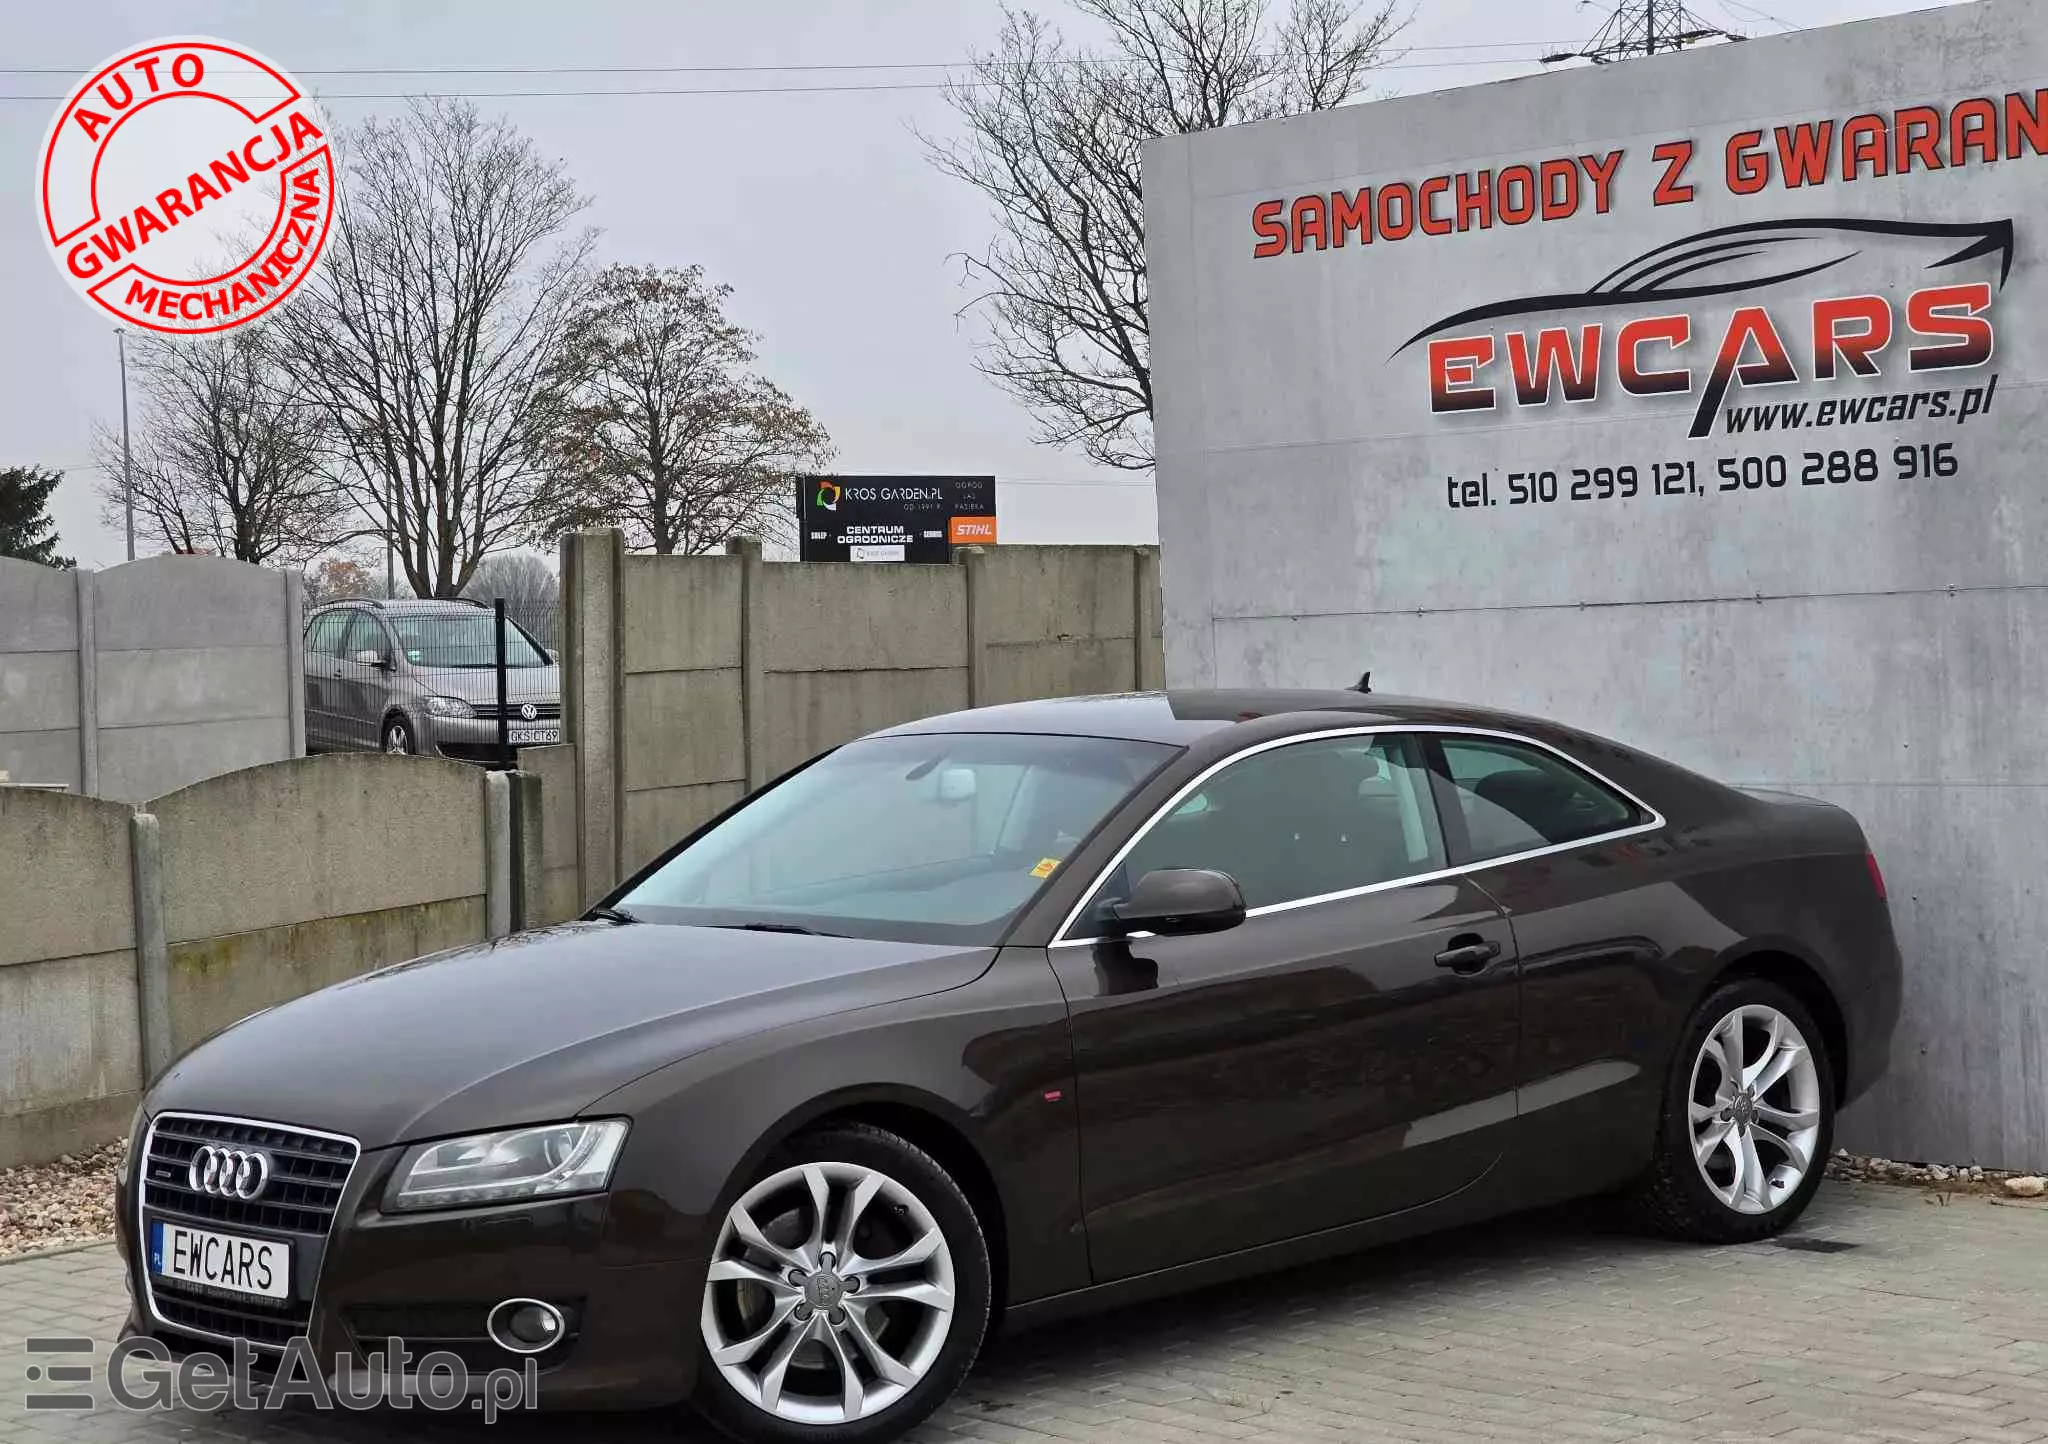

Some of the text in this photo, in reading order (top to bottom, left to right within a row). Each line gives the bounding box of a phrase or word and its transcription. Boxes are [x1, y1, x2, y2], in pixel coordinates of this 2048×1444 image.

[1252, 149, 1625, 258] SAMOCHODY
[1652, 139, 1694, 207] Z
[1427, 282, 1994, 439] EWCARS
[1725, 375, 1998, 435] www.ewcars.pl
[845, 487, 877, 501] KROS
[1447, 442, 1958, 508] tel. 510 299 121, 500 288 916
[837, 535, 914, 544] OGRODNICZE
[846, 525, 904, 535] CENTRUM
[955, 524, 992, 536] STIHL
[173, 1229, 273, 1290] EWCARS
